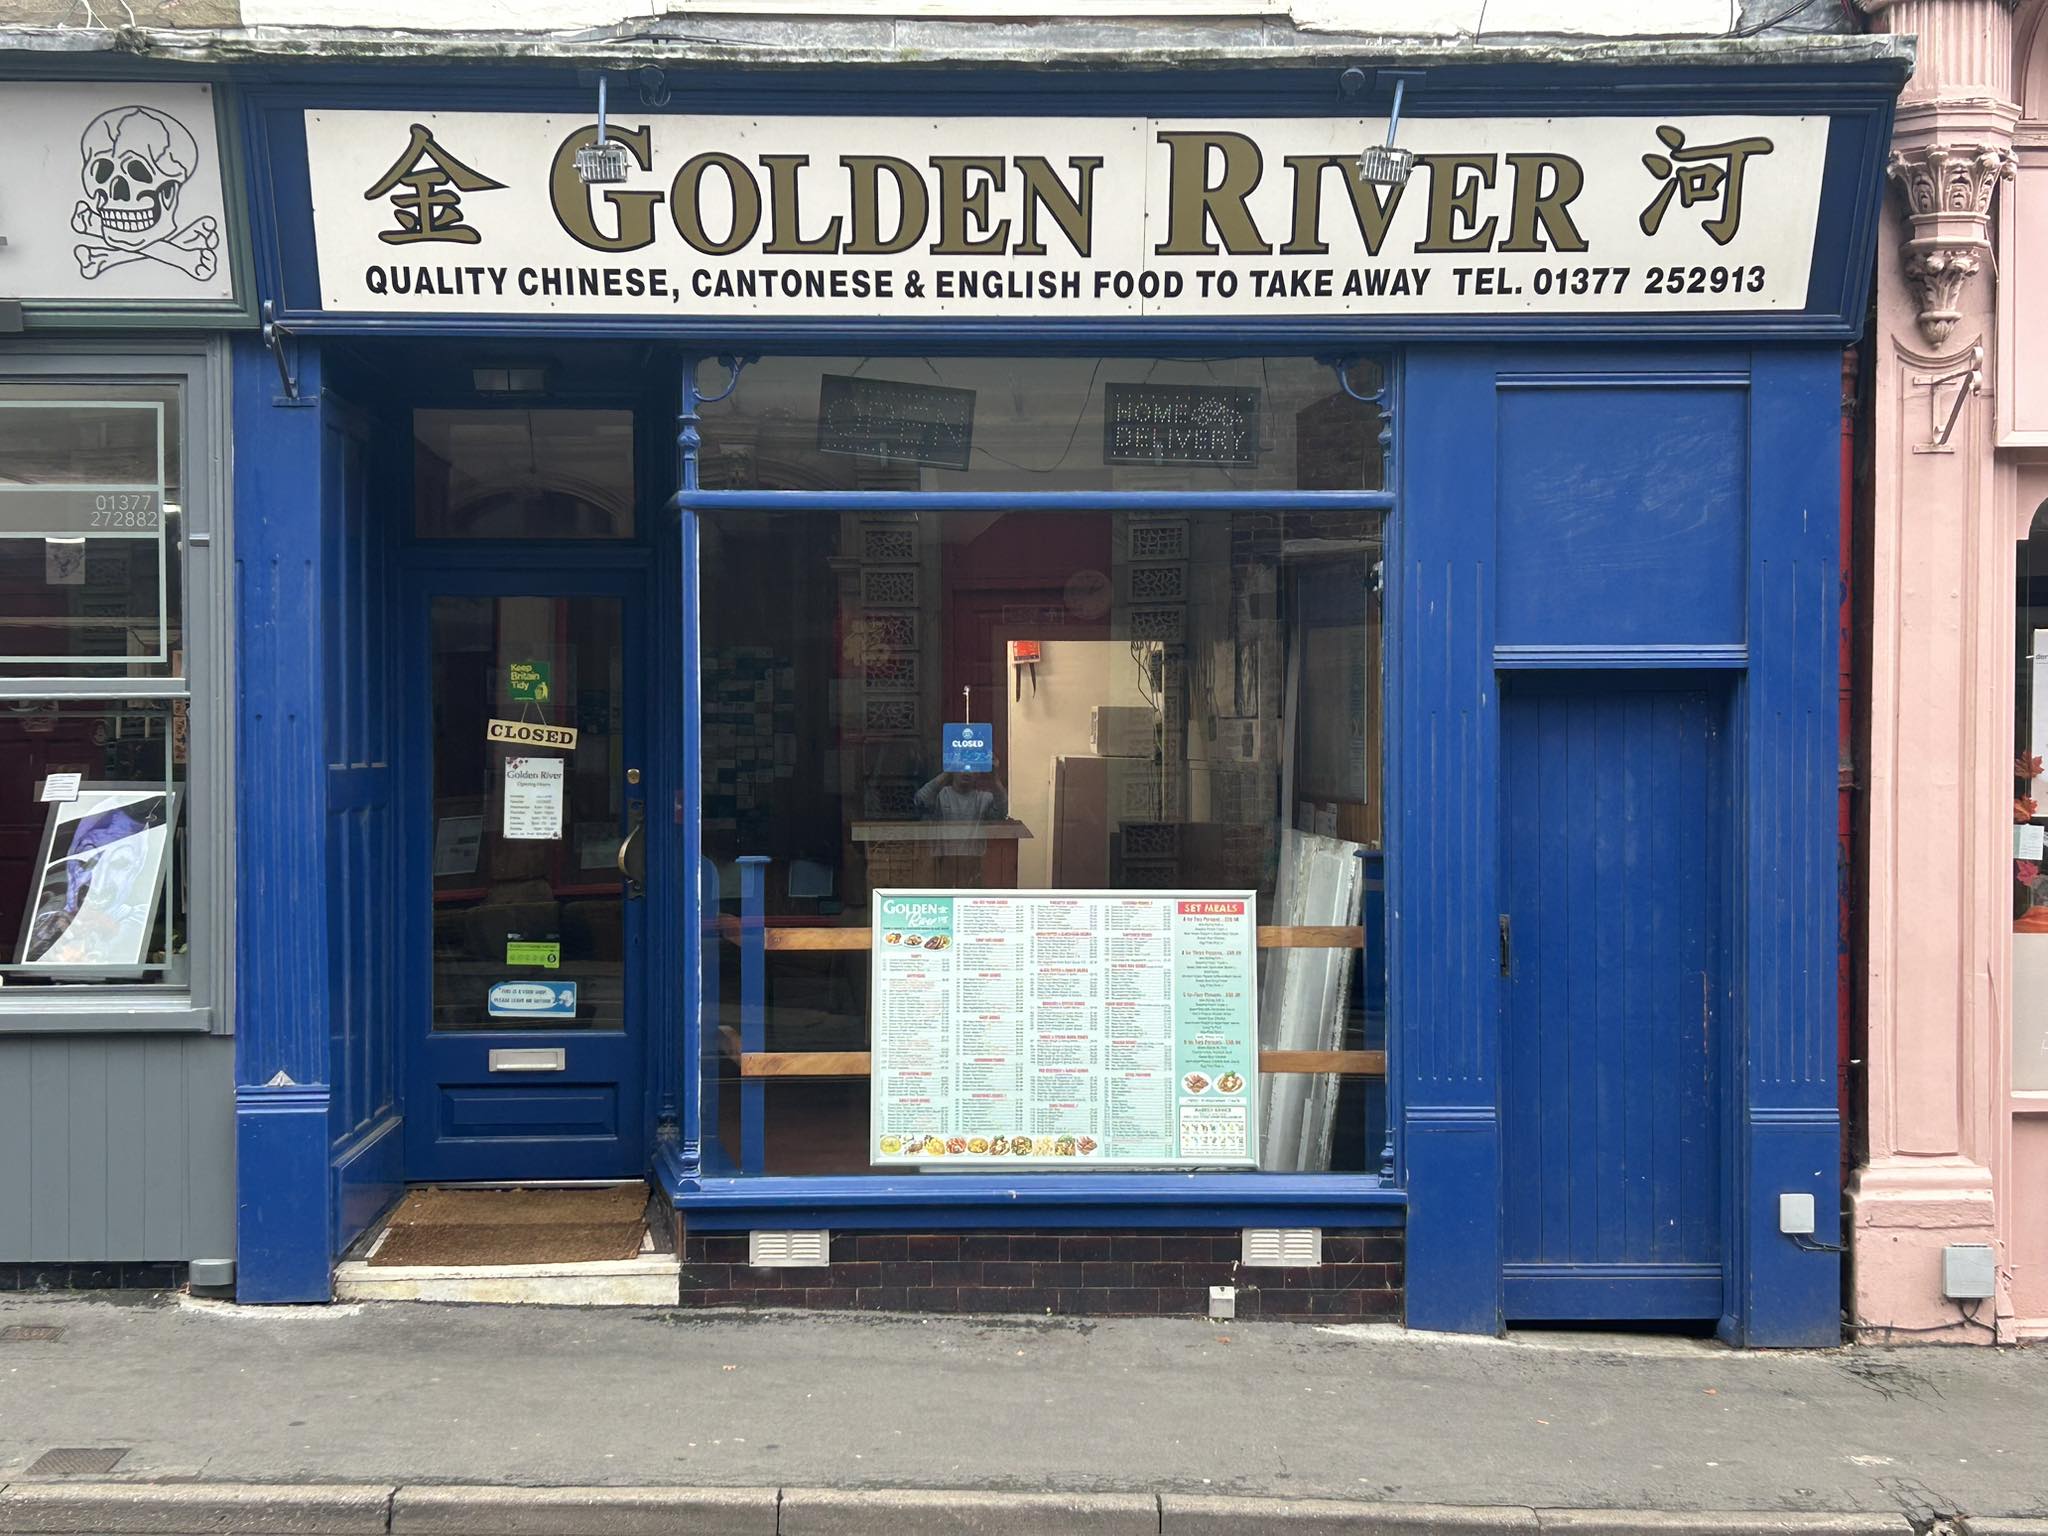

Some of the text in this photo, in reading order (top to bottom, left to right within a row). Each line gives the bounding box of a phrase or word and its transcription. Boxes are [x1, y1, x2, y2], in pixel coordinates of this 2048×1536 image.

[364, 123, 510, 246] 金
[549, 123, 1590, 258] GOLDEN RIVER
[1638, 124, 1775, 246] 河
[366, 265, 1766, 304] QUALITY CHINESE, CANTONESE & ENGLISH FOOD TO TAKE AWAY TEL. 01377 252913
[1116, 402, 1188, 424] HOME
[827, 397, 965, 448] OPEN
[1116, 427, 1245, 450] DELIVERY
[95, 495, 152, 511] 01377
[90, 511, 158, 527] 272882
[511, 663, 533, 672] Keep
[511, 671, 540, 681] Britain
[511, 681, 530, 691] Tidy
[490, 724, 574, 745] CLOSED
[952, 740, 984, 748] CLOSED
[506, 770, 562, 780] Golden River
[883, 900, 937, 914] GOLDEN
[1184, 903, 1238, 913] SET MEALS
